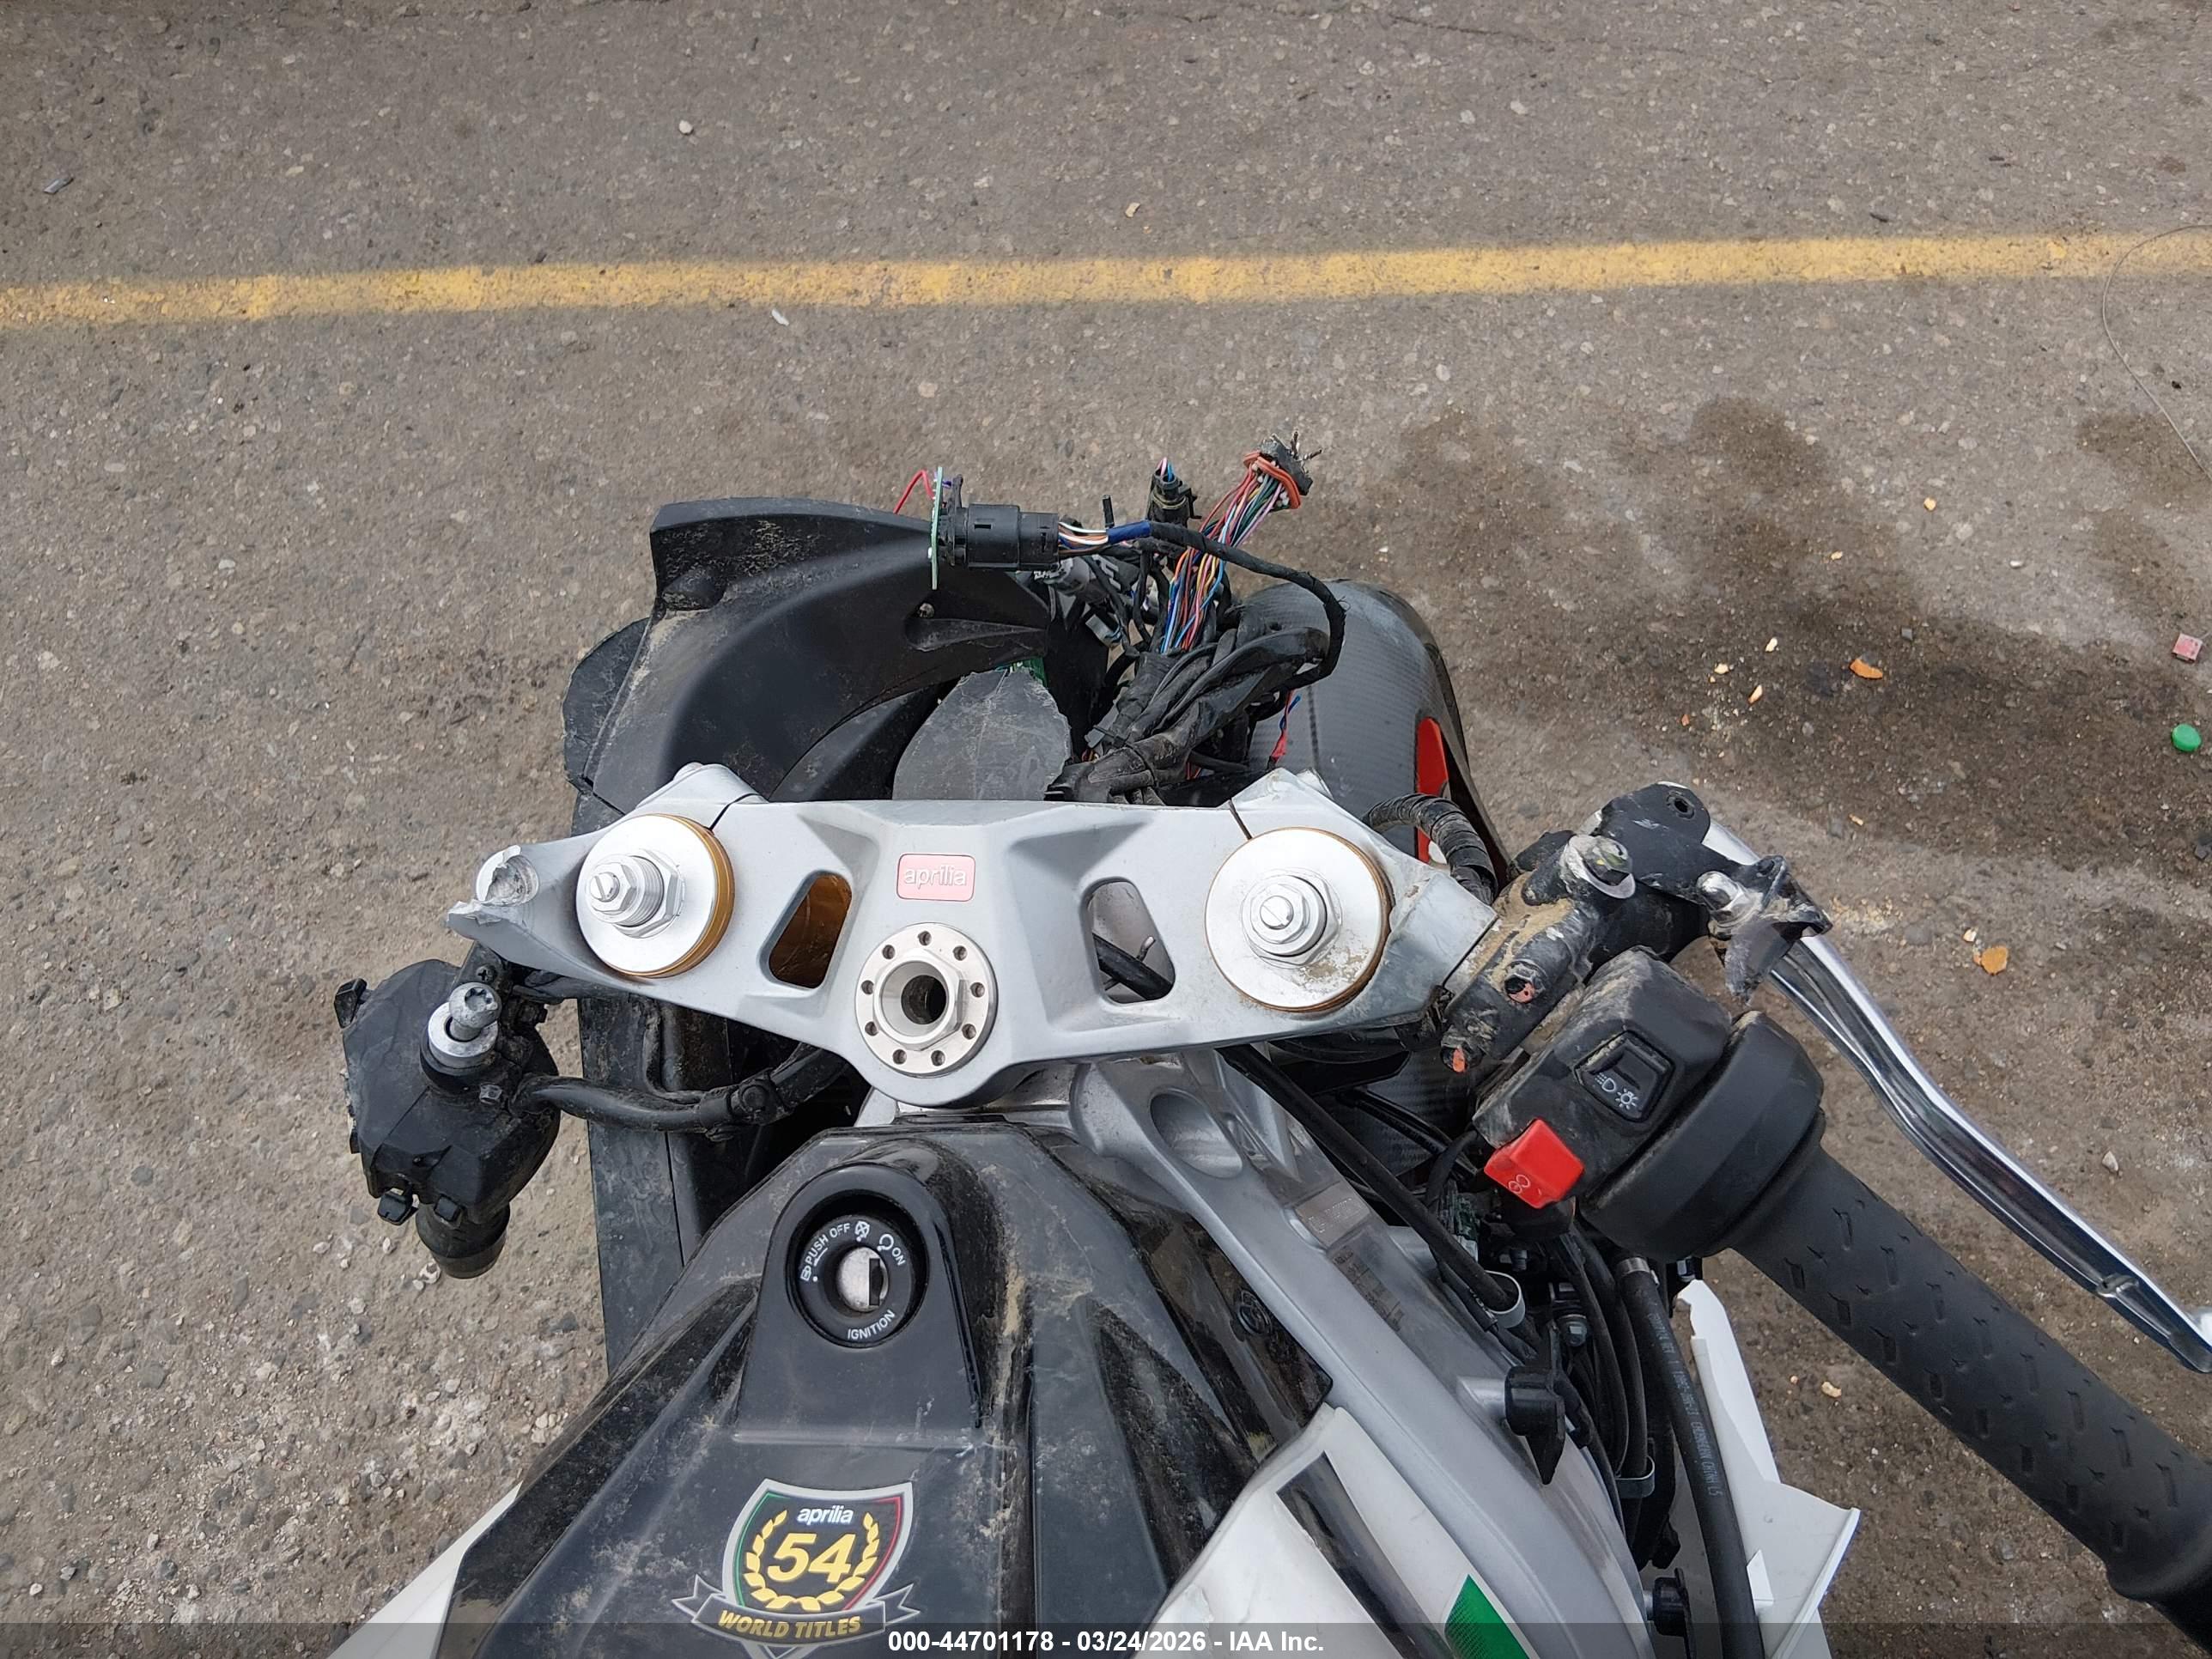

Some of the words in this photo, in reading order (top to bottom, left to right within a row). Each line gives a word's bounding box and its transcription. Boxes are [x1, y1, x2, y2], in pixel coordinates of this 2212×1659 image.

[904, 865, 967, 890] aprilia
[805, 1235, 829, 1267] PUSH
[830, 1223, 851, 1238] OFF
[891, 1247, 906, 1267] ON
[848, 1310, 896, 1340] IGNITION
[797, 1504, 854, 1525] aprilia
[767, 1533, 856, 1583] 54
[718, 1610, 790, 1638] WORLD
[795, 1616, 861, 1638] TITLES
